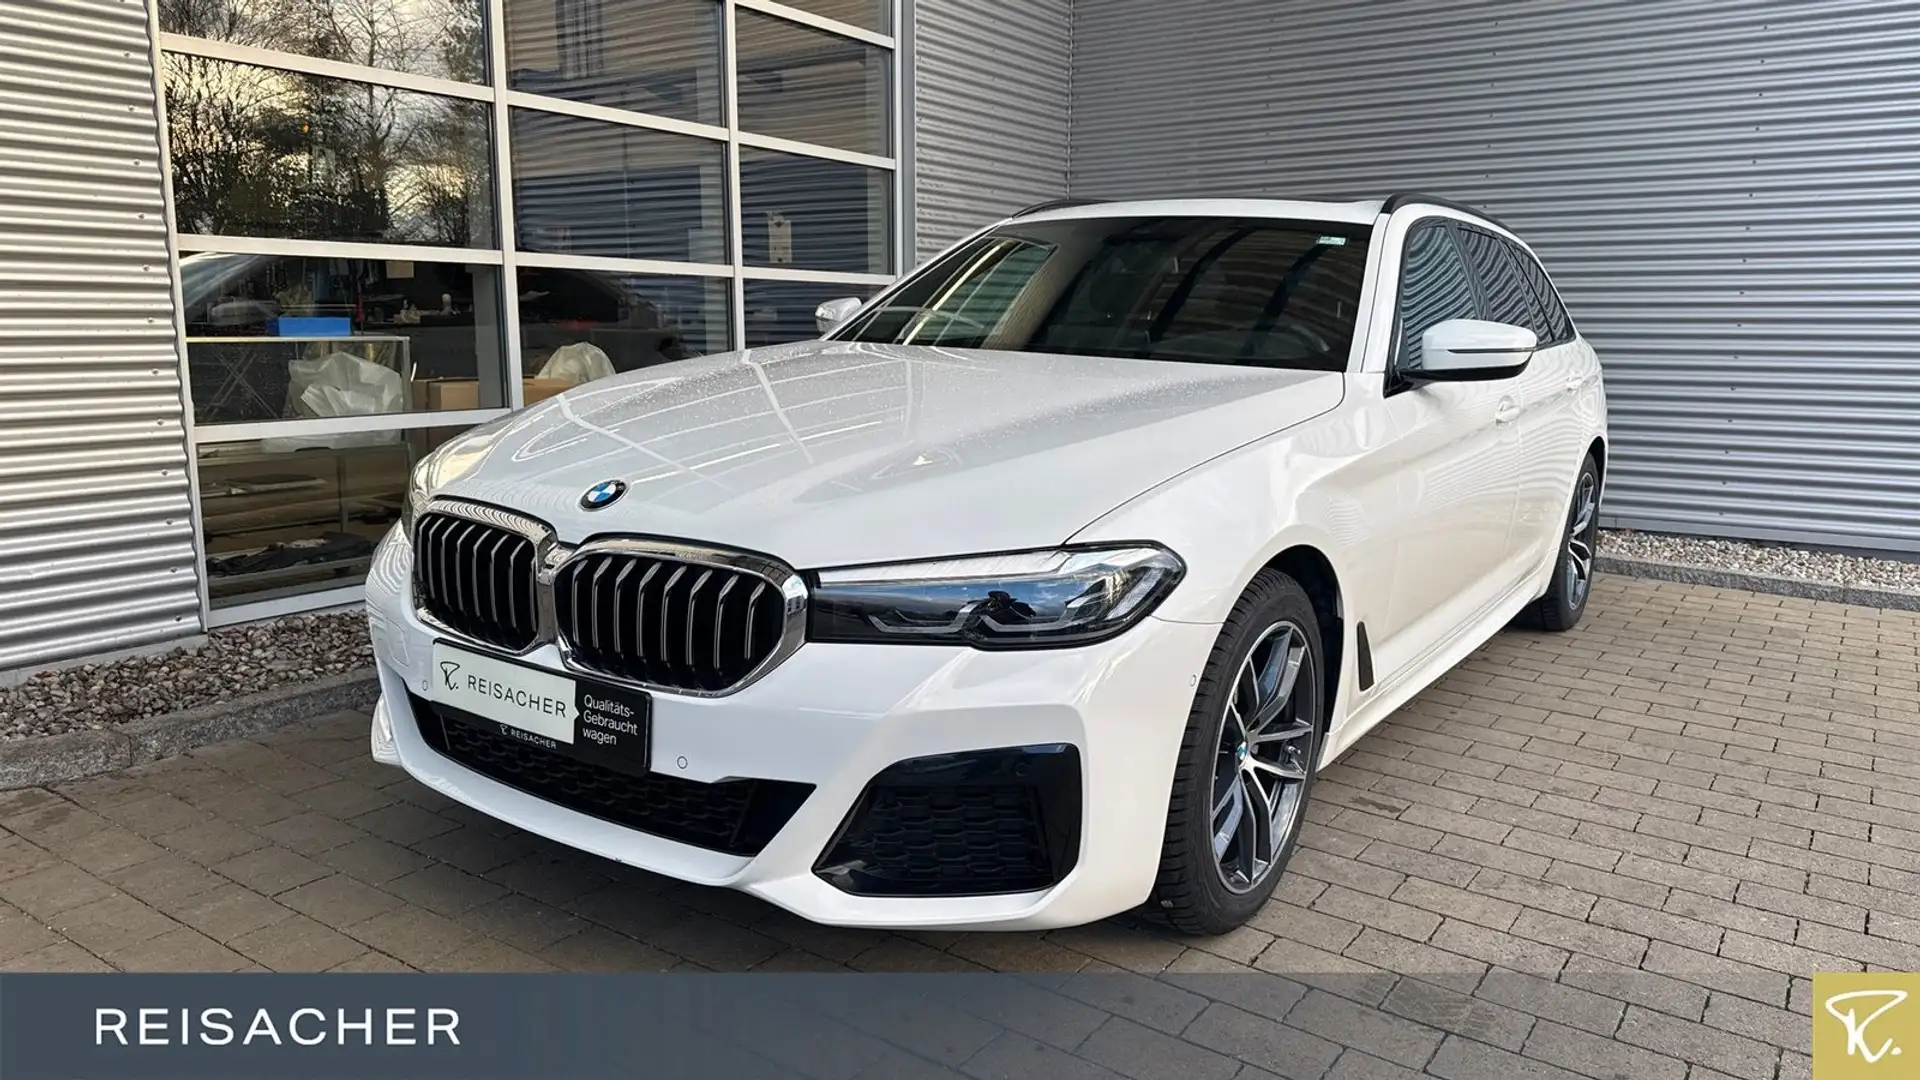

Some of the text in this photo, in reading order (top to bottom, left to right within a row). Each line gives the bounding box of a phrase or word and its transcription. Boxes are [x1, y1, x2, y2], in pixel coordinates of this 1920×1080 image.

[467, 675, 567, 718] REISACHER
[584, 694, 635, 718] Qualitäts-
[583, 711, 638, 736] Gebraucht
[511, 728, 557, 749] REISACHER
[583, 728, 617, 746] wagen
